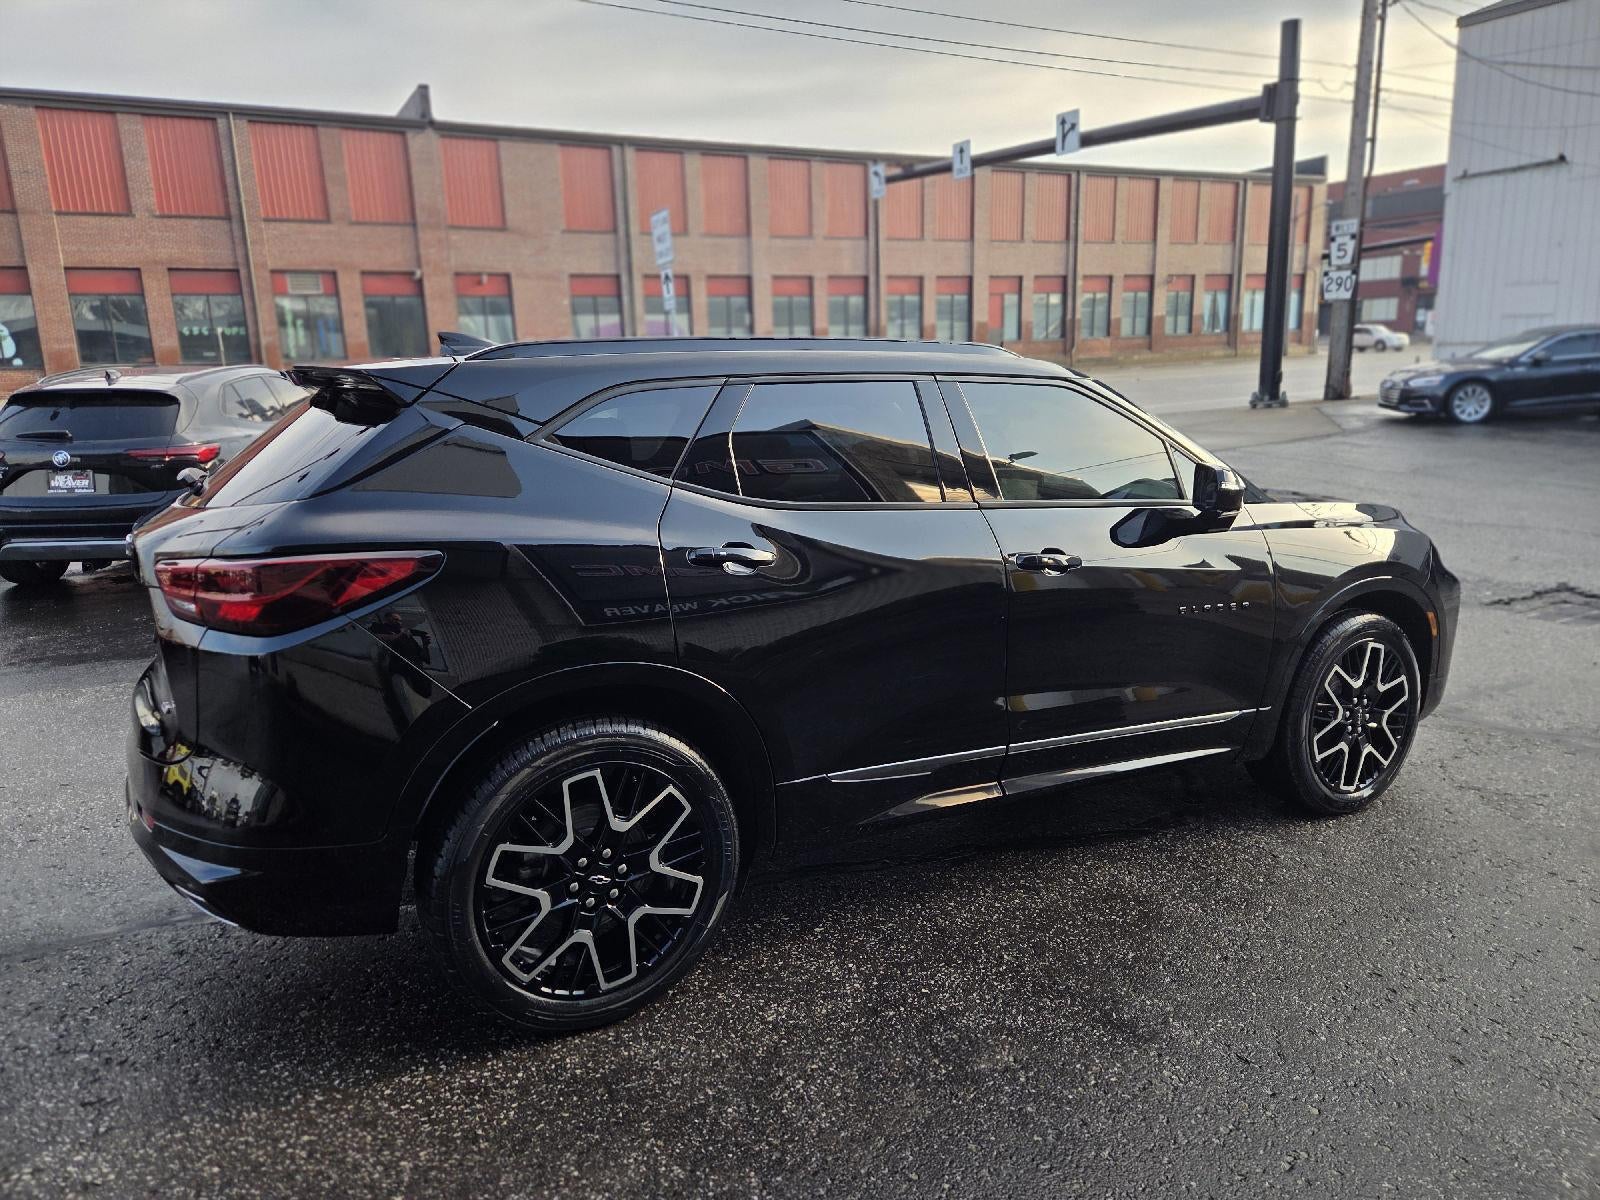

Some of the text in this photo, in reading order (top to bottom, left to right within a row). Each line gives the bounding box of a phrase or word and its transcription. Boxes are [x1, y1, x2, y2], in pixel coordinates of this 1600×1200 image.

[1337, 243, 1348, 259] 5
[1325, 276, 1353, 293] 290
[50, 479, 90, 487] WEAVER
